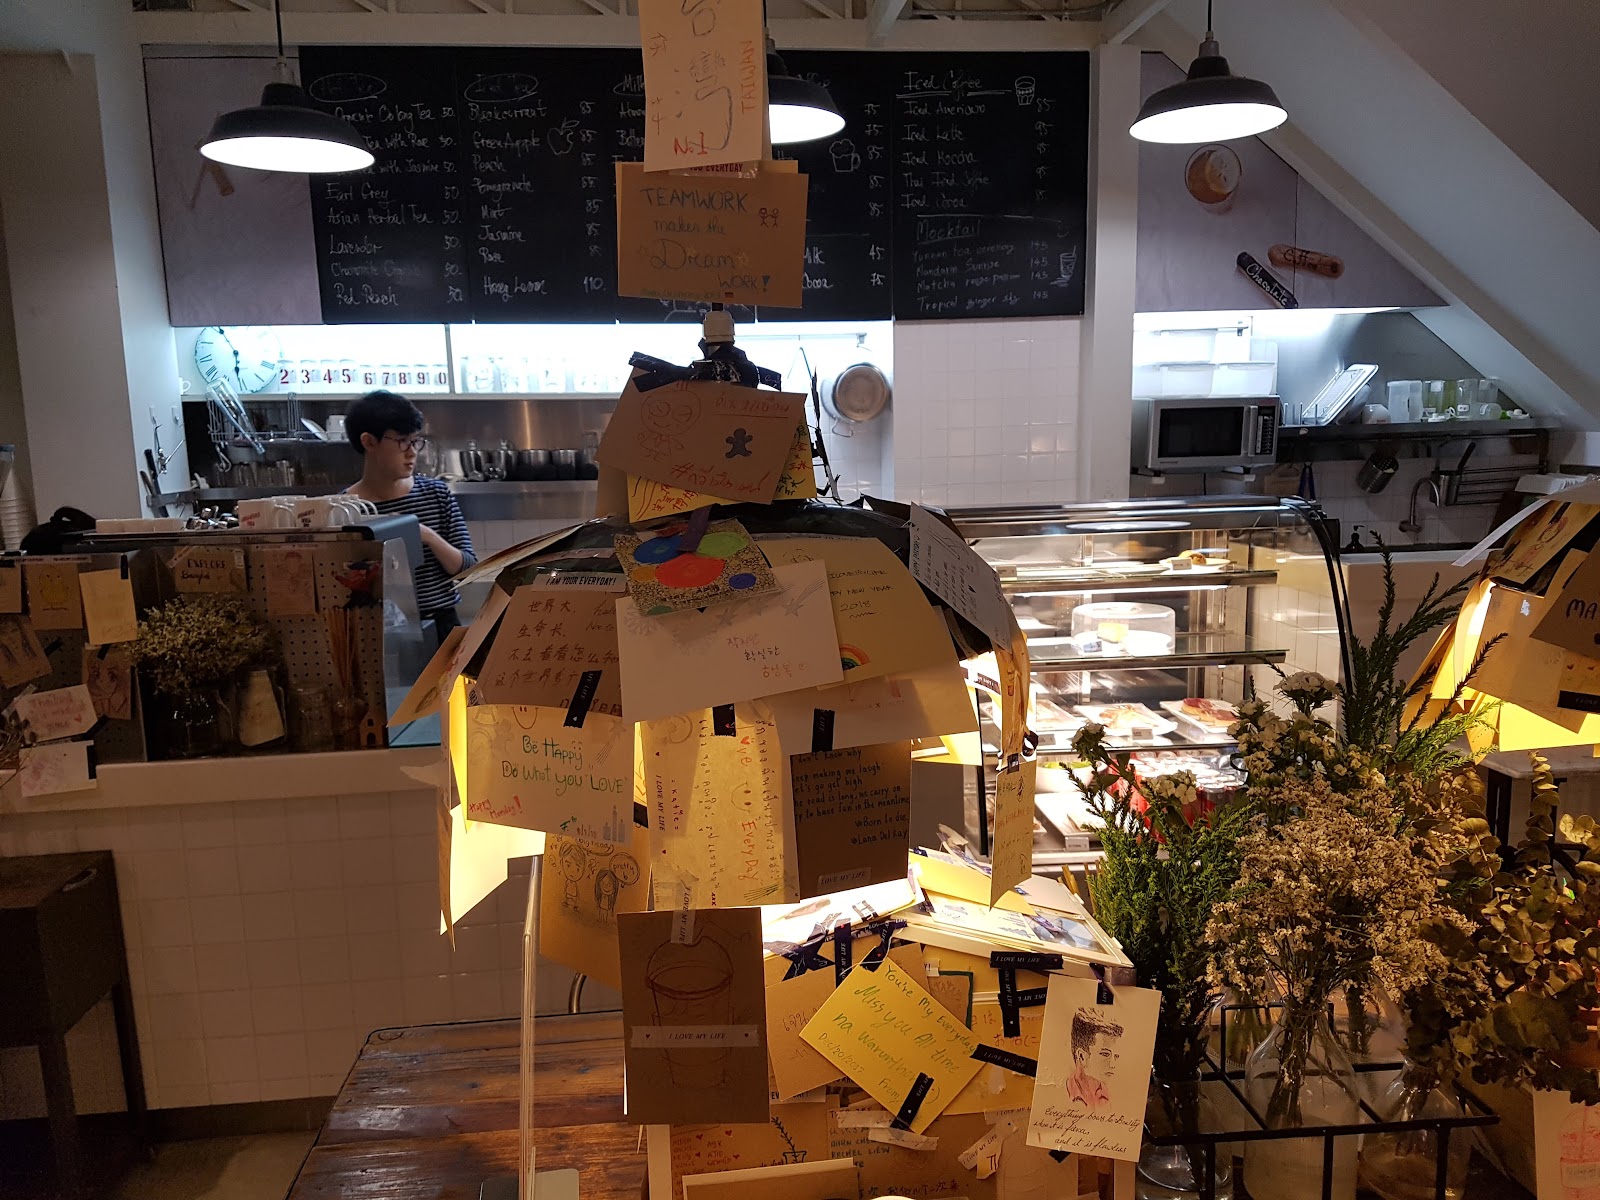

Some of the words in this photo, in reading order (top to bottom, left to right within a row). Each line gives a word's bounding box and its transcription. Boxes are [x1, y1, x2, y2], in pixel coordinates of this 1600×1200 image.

[904, 71, 939, 90] Iced
[411, 103, 436, 120] Tea
[325, 182, 353, 201] Earl
[640, 187, 748, 213] TEAMWORK
[327, 207, 360, 225] Asian
[408, 204, 434, 224] Tea
[707, 216, 726, 236] the
[916, 219, 981, 241] Mocktail
[650, 238, 736, 269] Dream
[1246, 263, 1288, 306] Chocolate
[562, 576, 578, 586] YOUR
[579, 576, 617, 586] EVERYDAY!
[840, 600, 871, 612] 2018
[522, 735, 539, 754] Be
[502, 760, 518, 777] Do
[590, 775, 625, 794] LOVE
[813, 768, 842, 781] making
[859, 761, 880, 775] laugh
[656, 780, 664, 799] LOVE
[815, 783, 824, 794] go
[845, 775, 862, 790] high
[870, 786, 889, 797] carry
[657, 802, 664, 813] MY
[864, 800, 874, 809] the
[854, 985, 885, 1013] Miss
[884, 965, 913, 998] You're
[918, 997, 934, 1018] My
[936, 1015, 977, 1054] Everyday
[1044, 1105, 1085, 1124] Everything
[979, 1143, 987, 1151] MY
[1054, 1136, 1072, 1145] and
